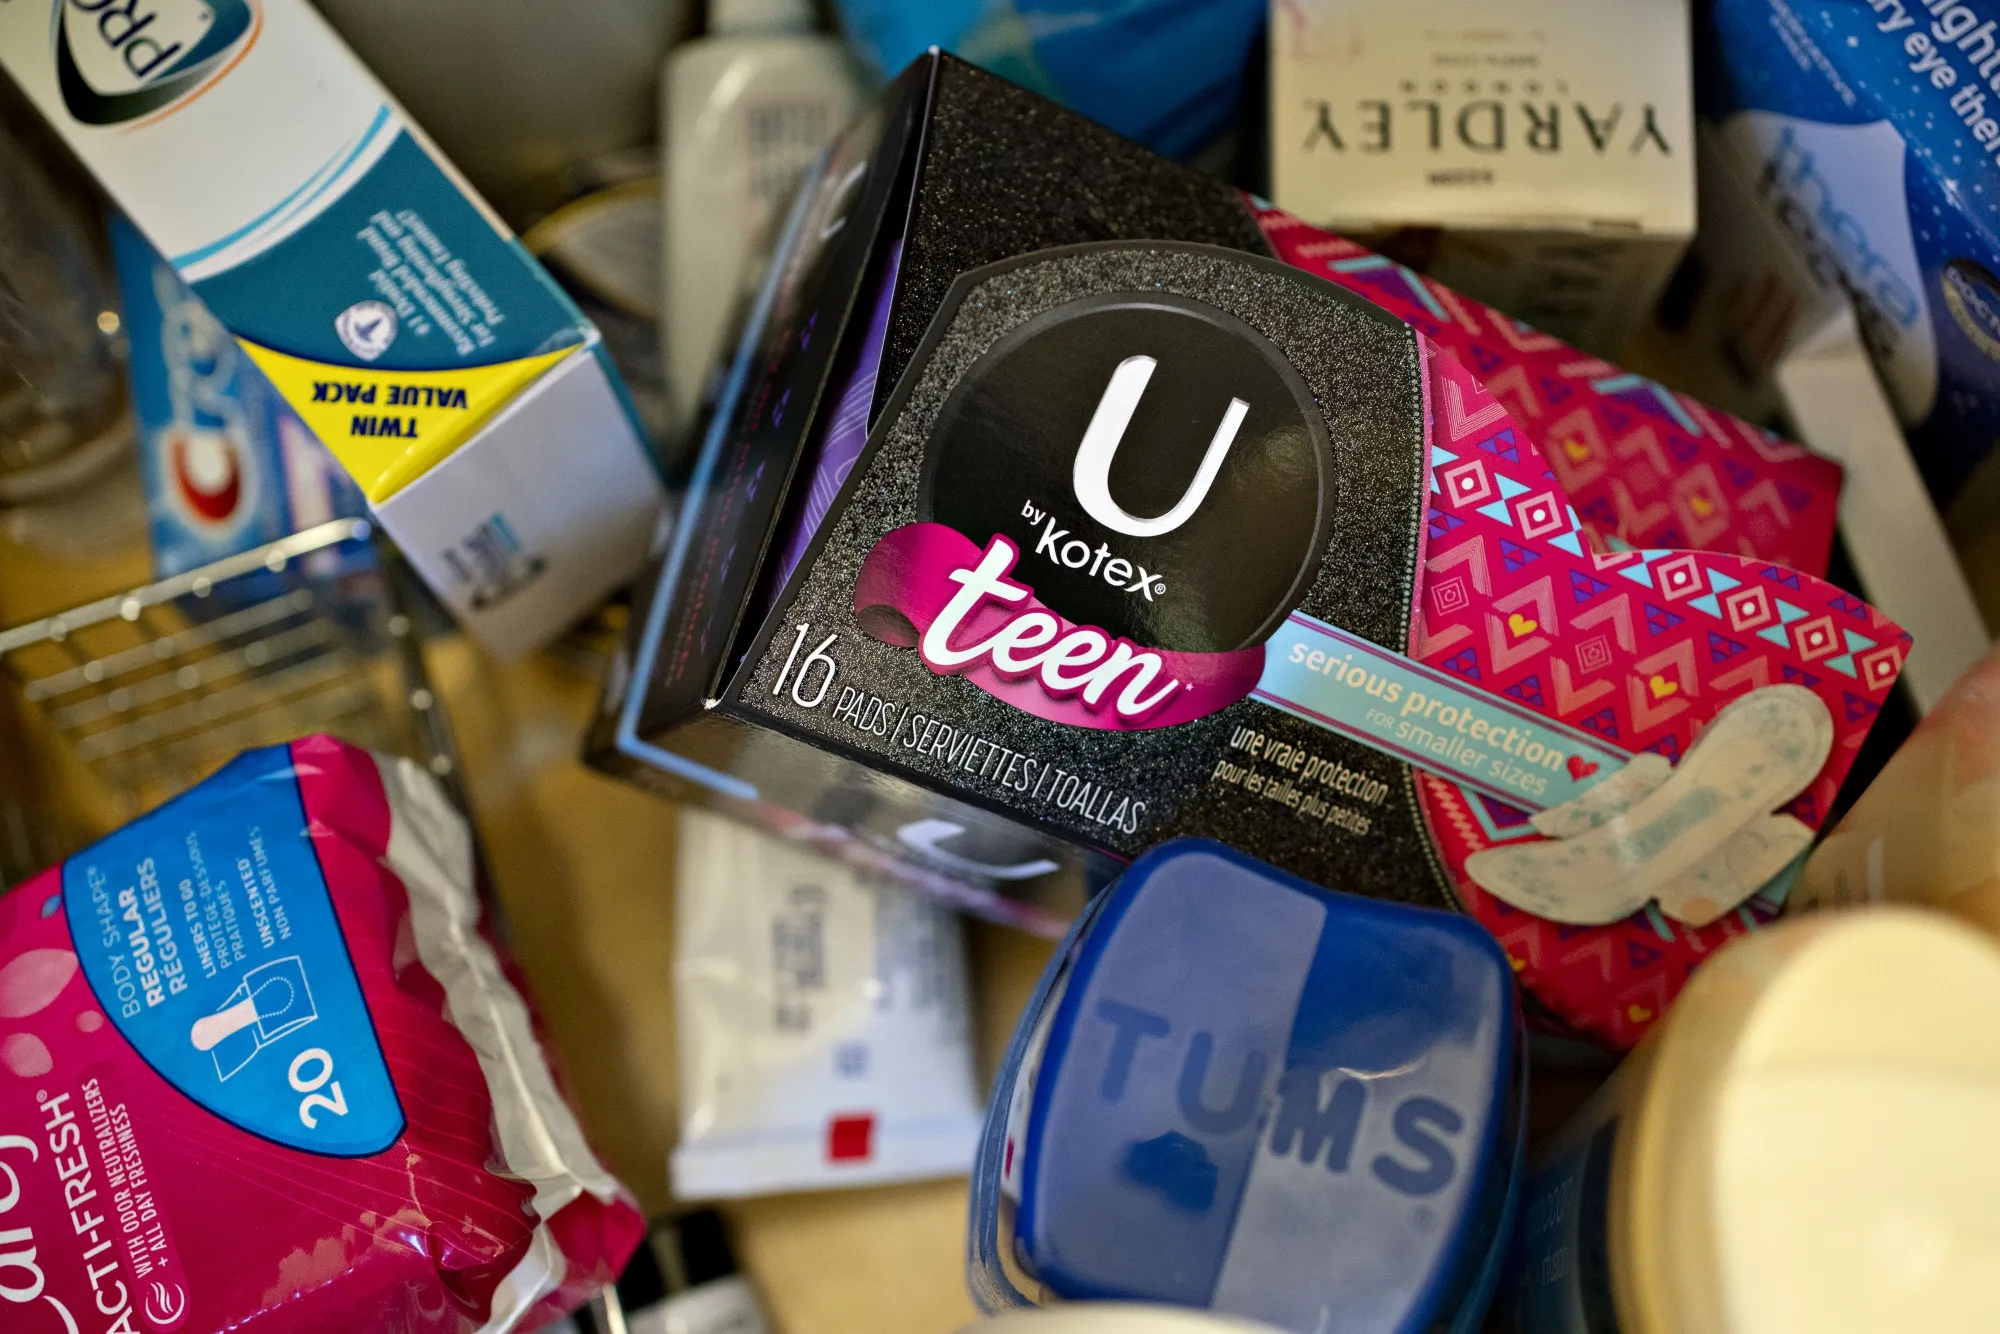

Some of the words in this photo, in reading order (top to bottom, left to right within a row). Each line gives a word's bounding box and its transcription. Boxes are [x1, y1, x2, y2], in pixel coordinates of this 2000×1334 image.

[1302, 98, 1673, 156] YARDLEY
[1904, 31, 1958, 89] eye
[1950, 82, 2000, 168] ther
[311, 381, 378, 404] PACK
[351, 416, 418, 438] TWIN
[386, 384, 468, 409] VALUE
[1073, 354, 1251, 537] U
[1020, 499, 1046, 526] by
[771, 621, 839, 708] 16
[831, 686, 899, 738] PADS
[902, 714, 1038, 792] SERVIETTES
[1046, 769, 1148, 836] TOALLAS
[1287, 641, 1404, 704] serious
[1399, 688, 1565, 773] protection
[1230, 725, 1265, 757] une
[1262, 738, 1306, 773] vraie
[1299, 755, 1389, 806] protection
[1365, 707, 1396, 731] FOR
[1395, 719, 1489, 772] smaller
[1487, 759, 1550, 796] sizes
[1210, 760, 1248, 785] pour
[1244, 765, 1266, 793] les
[1262, 776, 1303, 809] tailles
[1297, 791, 1330, 819] plus
[1324, 803, 1373, 836] petites
[179, 878, 194, 901] GO
[184, 901, 199, 922] TO
[215, 880, 247, 962] PRATIQUES
[273, 905, 292, 940] NON
[118, 886, 165, 1008] REGULAR
[136, 857, 188, 996] RÉGULIERS
[190, 922, 217, 979] LINERS
[108, 953, 141, 1019] BODY
[288, 1047, 349, 1129] 20
[1095, 999, 1464, 1198] TUMS
[81, 1077, 127, 1189] NEUTRALIZERS
[109, 1102, 148, 1191] FRESHNESS
[114, 1187, 141, 1233] ODOR
[135, 1190, 159, 1223] DAY
[148, 1222, 168, 1252] ALL
[127, 1230, 154, 1279] WITH
